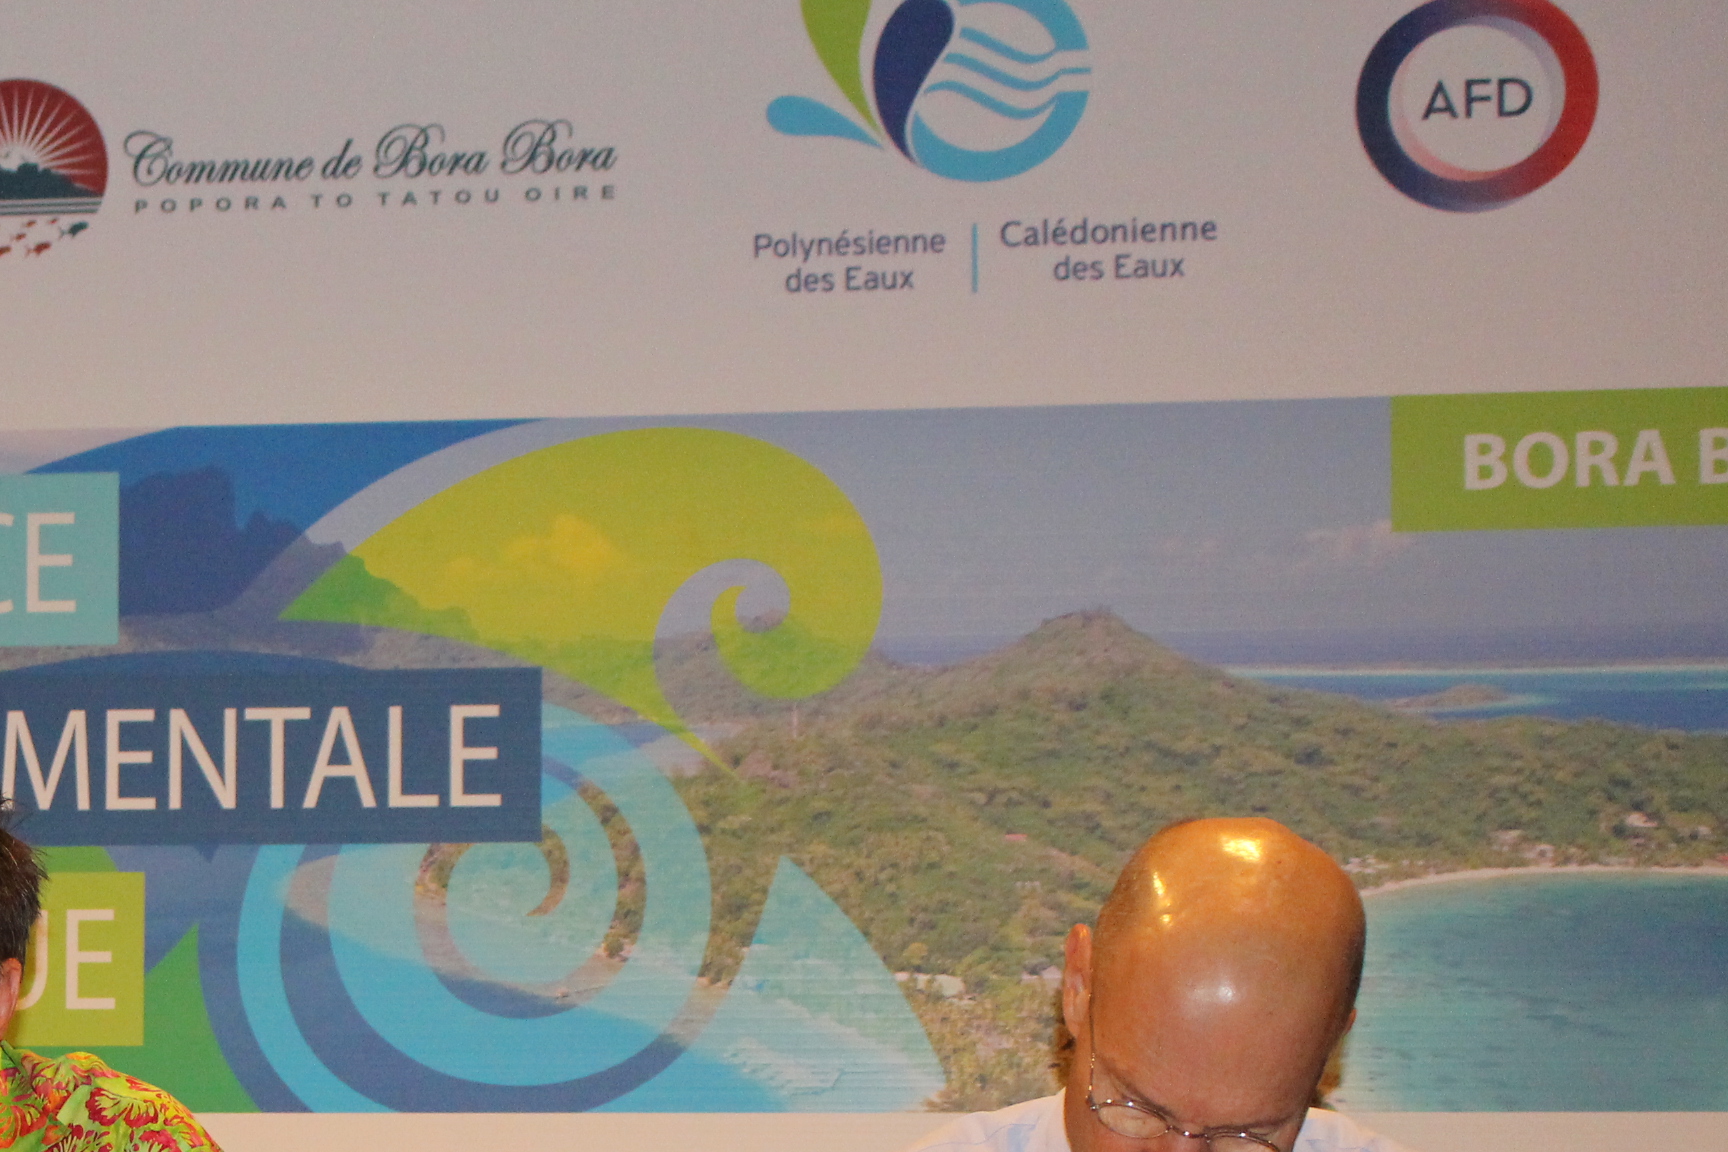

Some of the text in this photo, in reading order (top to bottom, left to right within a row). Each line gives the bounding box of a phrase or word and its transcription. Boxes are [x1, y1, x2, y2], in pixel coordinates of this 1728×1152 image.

[1421, 77, 1534, 120] AFD
[123, 118, 619, 187] Commune de Bora Bora
[135, 184, 618, 214] POPORA TO TATOU OIRE
[752, 228, 947, 263] Polynésienne
[999, 216, 1218, 249] Calédonienne
[785, 266, 915, 294] des Eaux
[1053, 253, 1186, 283] des Eaux
[1463, 428, 1676, 491] BORA
